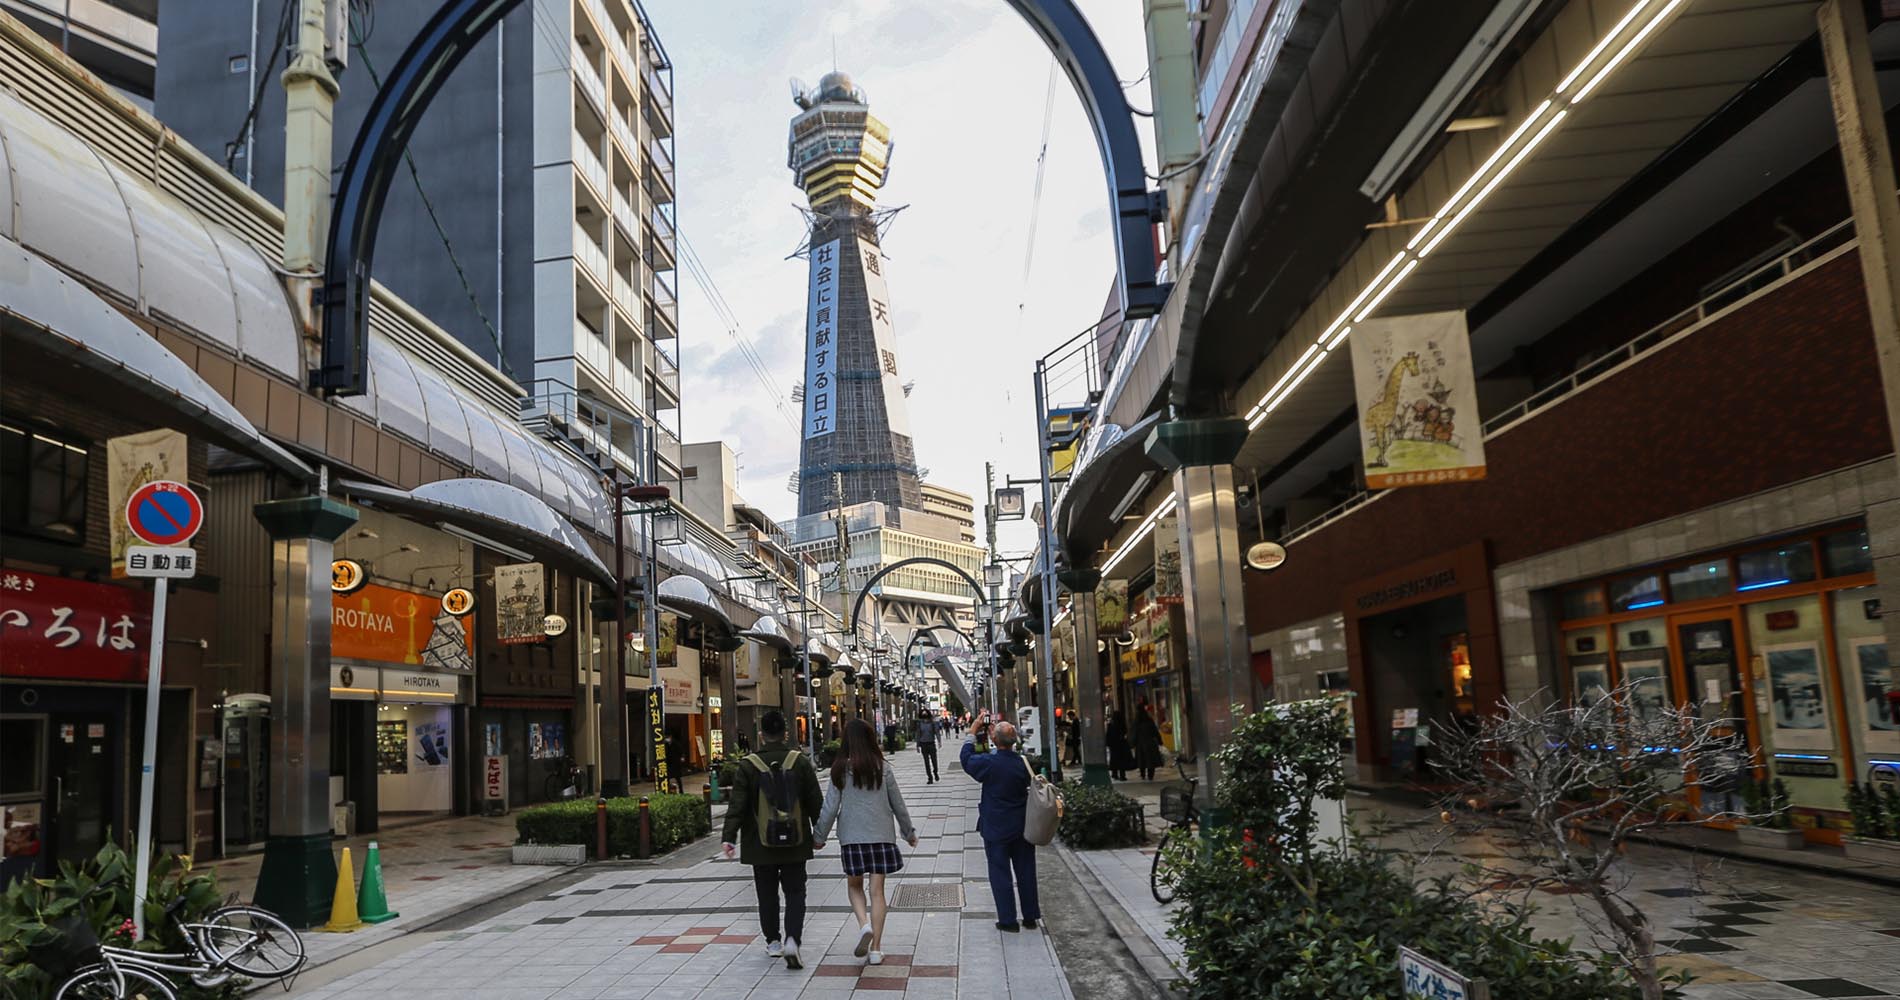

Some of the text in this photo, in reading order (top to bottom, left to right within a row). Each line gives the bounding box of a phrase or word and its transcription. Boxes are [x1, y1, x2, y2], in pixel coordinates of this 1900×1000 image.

[863, 249, 897, 377] 通天閣
[813, 245, 832, 434] 社会に貢献する日立
[155, 482, 179, 493] 9-22
[130, 554, 193, 571] 自動車
[0, 574, 35, 592] 焼き
[0, 606, 136, 650] いろは
[331, 606, 394, 633] IROTAYA
[404, 677, 440, 688] HIROTAYA
[488, 758, 500, 798] たばこ
